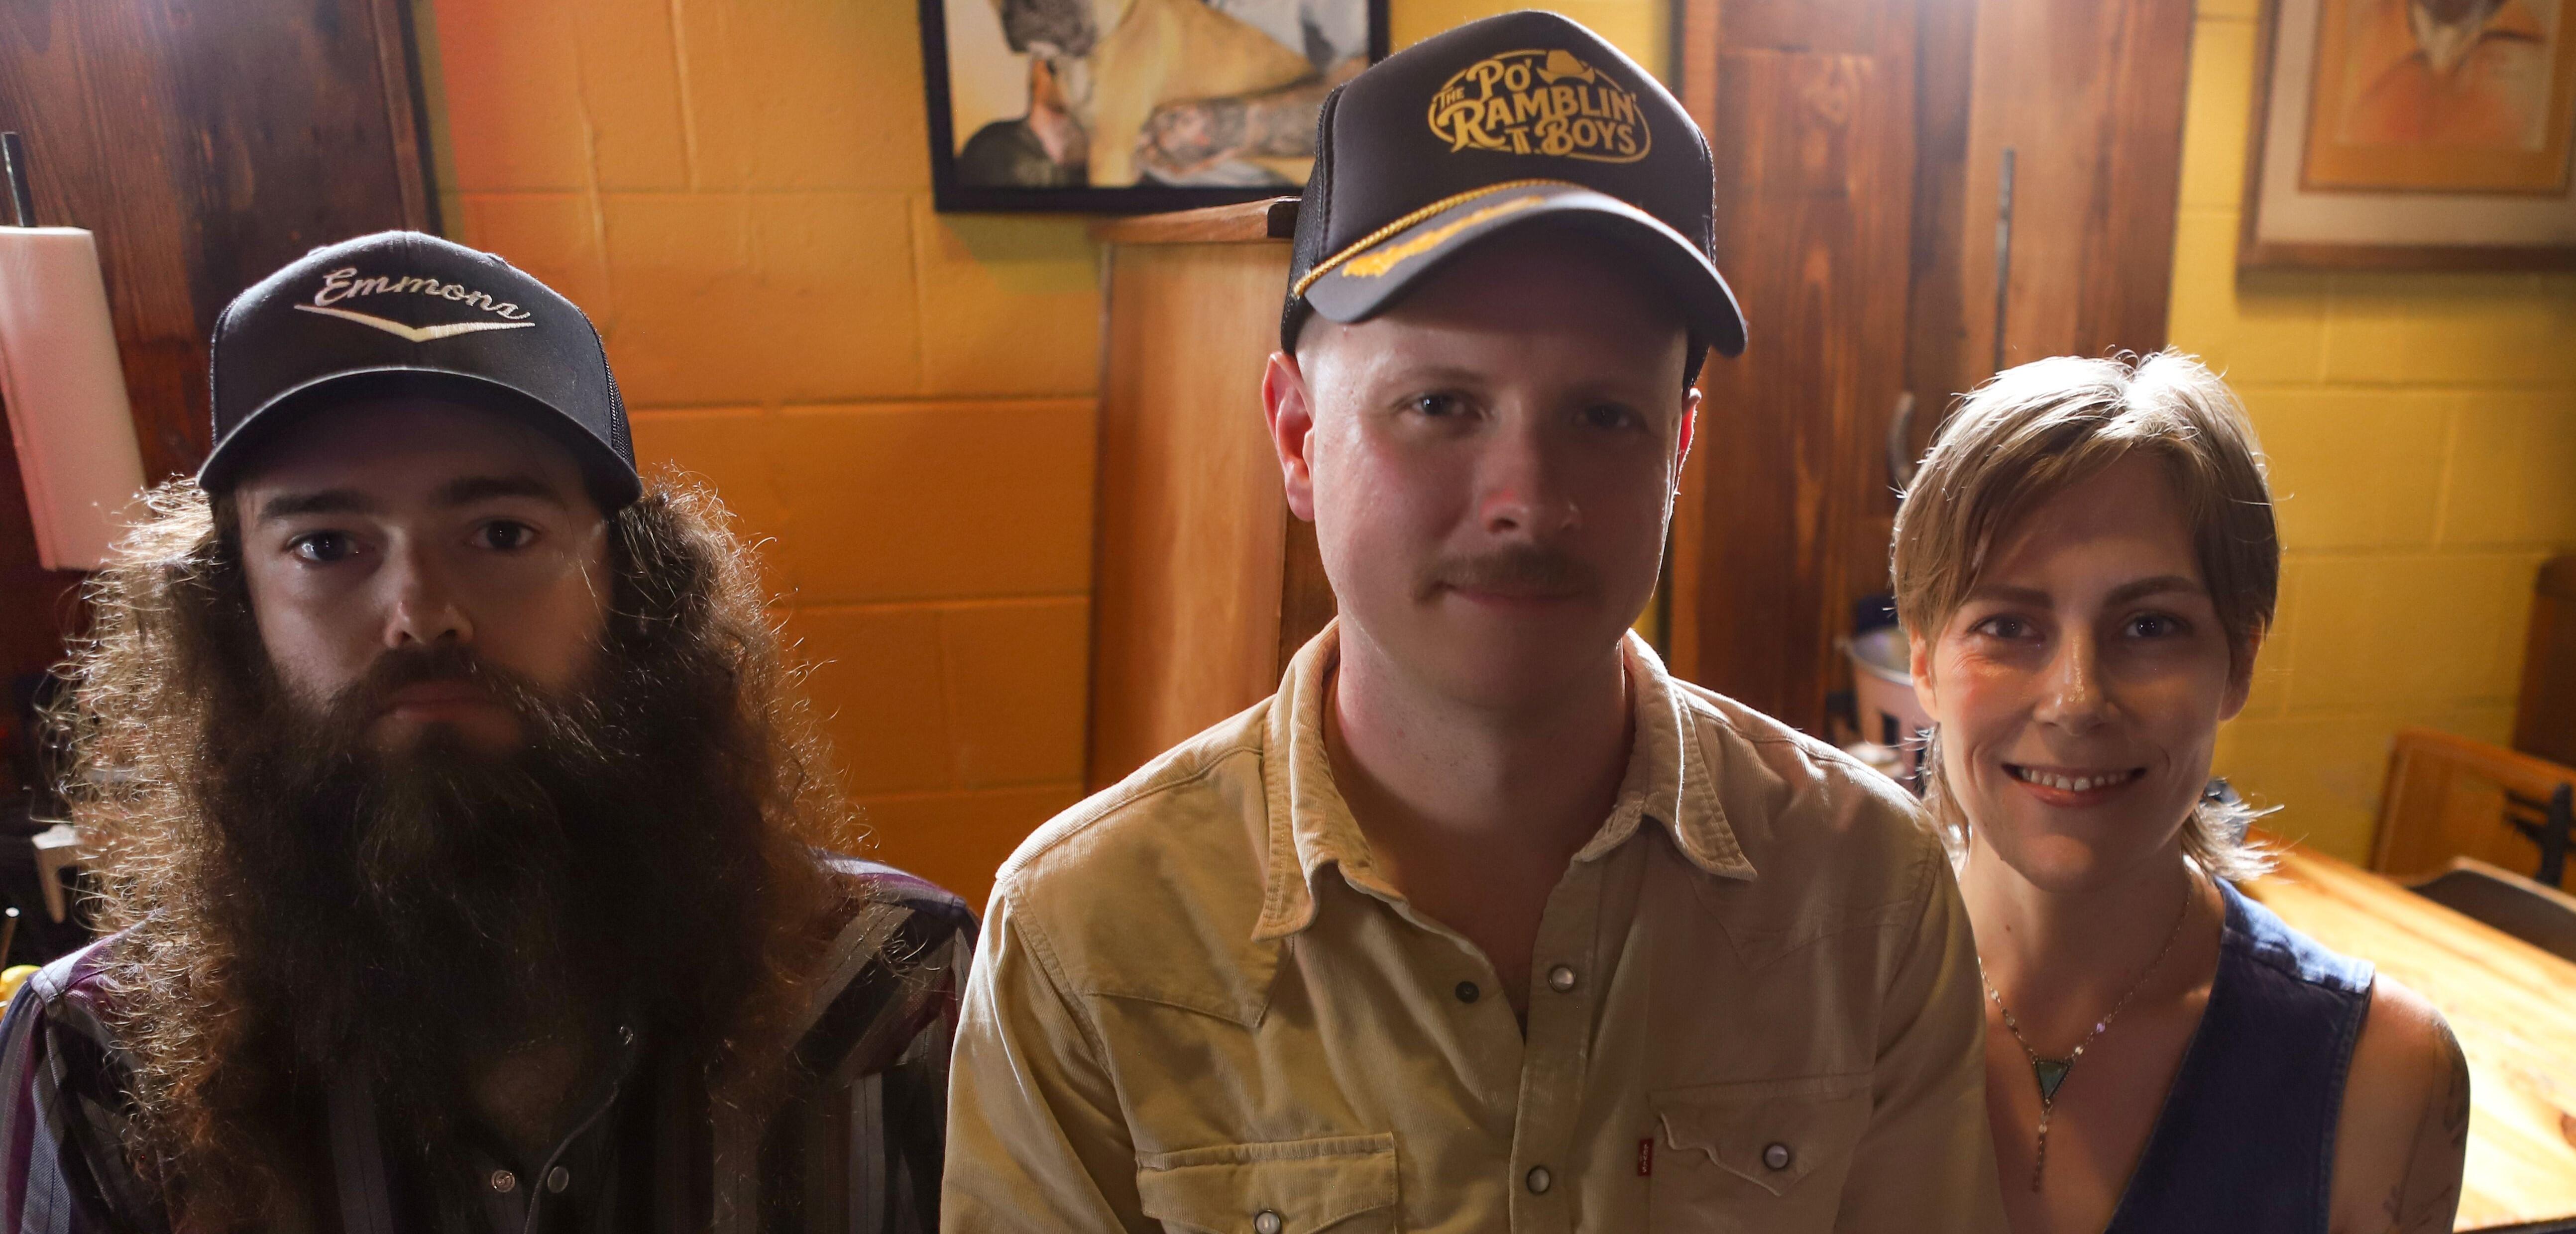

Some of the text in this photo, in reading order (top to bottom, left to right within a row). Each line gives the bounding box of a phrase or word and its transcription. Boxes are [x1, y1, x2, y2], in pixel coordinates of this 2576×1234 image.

[1433, 87, 1465, 108] THE
[1437, 86, 1637, 153] RAMBLIN'
[1535, 118, 1637, 156] BOYS
[314, 267, 531, 319] Emmons
